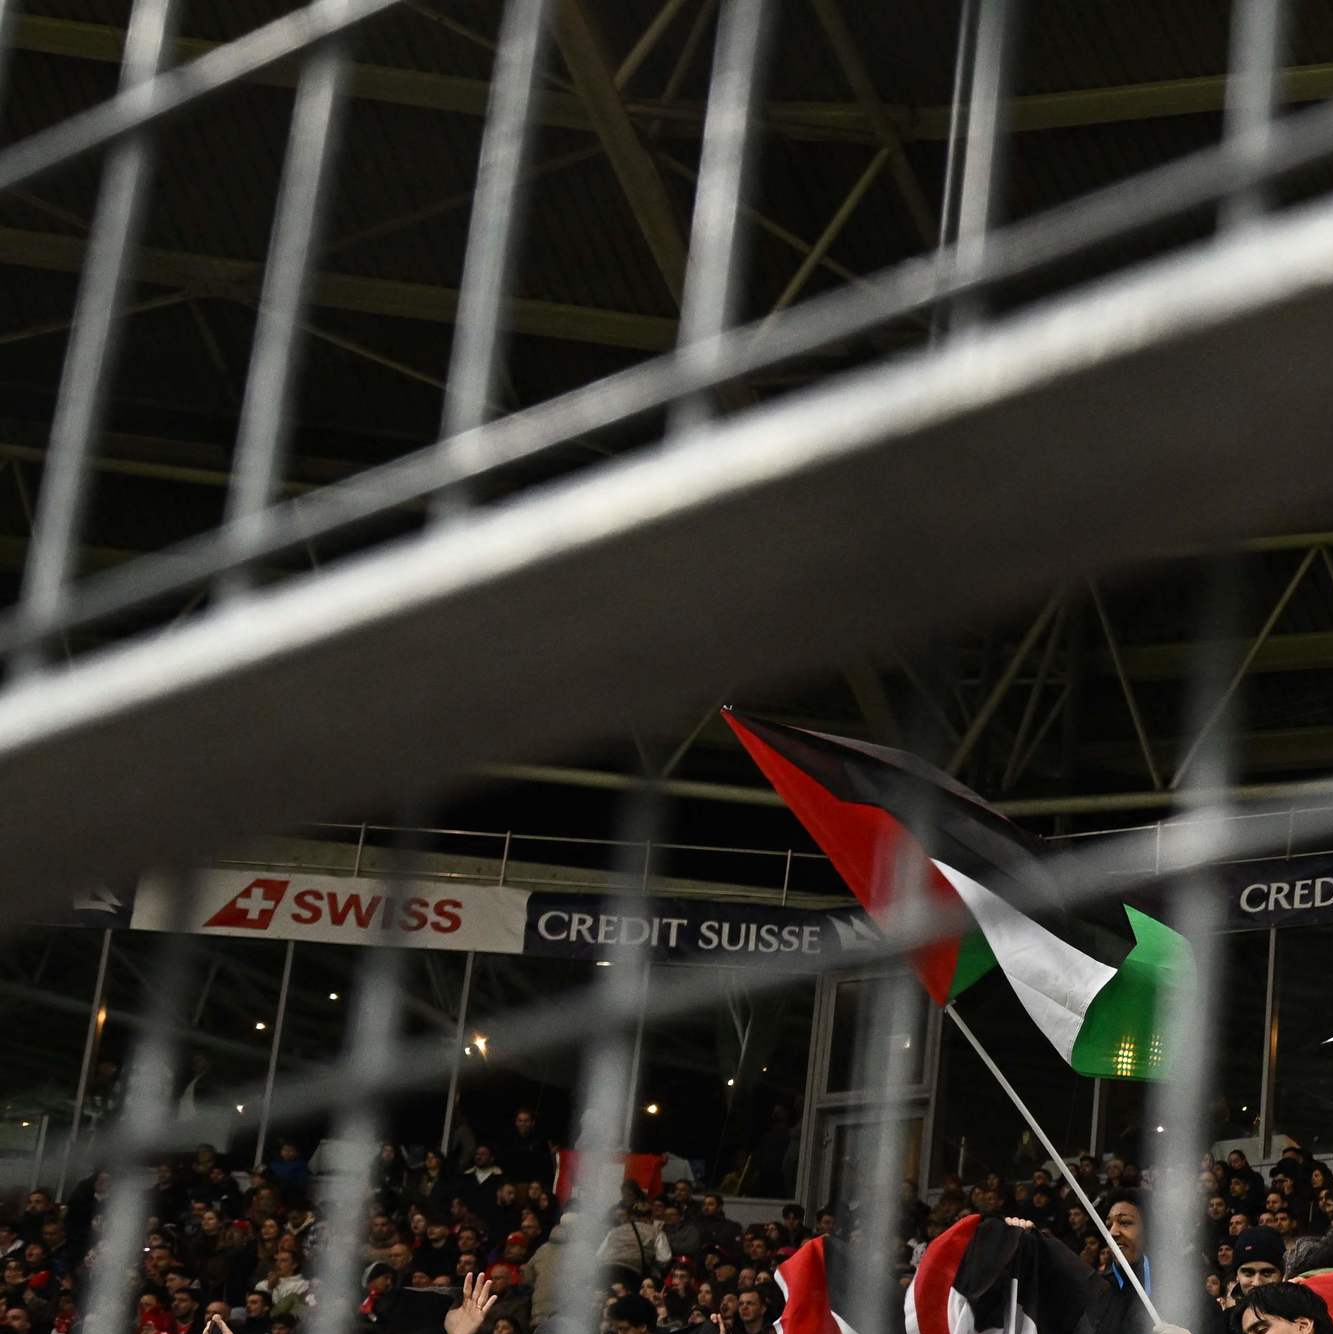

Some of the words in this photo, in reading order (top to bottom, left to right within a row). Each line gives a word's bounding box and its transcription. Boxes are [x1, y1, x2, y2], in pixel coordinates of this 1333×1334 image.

[290, 888, 463, 934] SWISS
[537, 910, 688, 948] CREDIT
[698, 919, 822, 954] SUISSE
